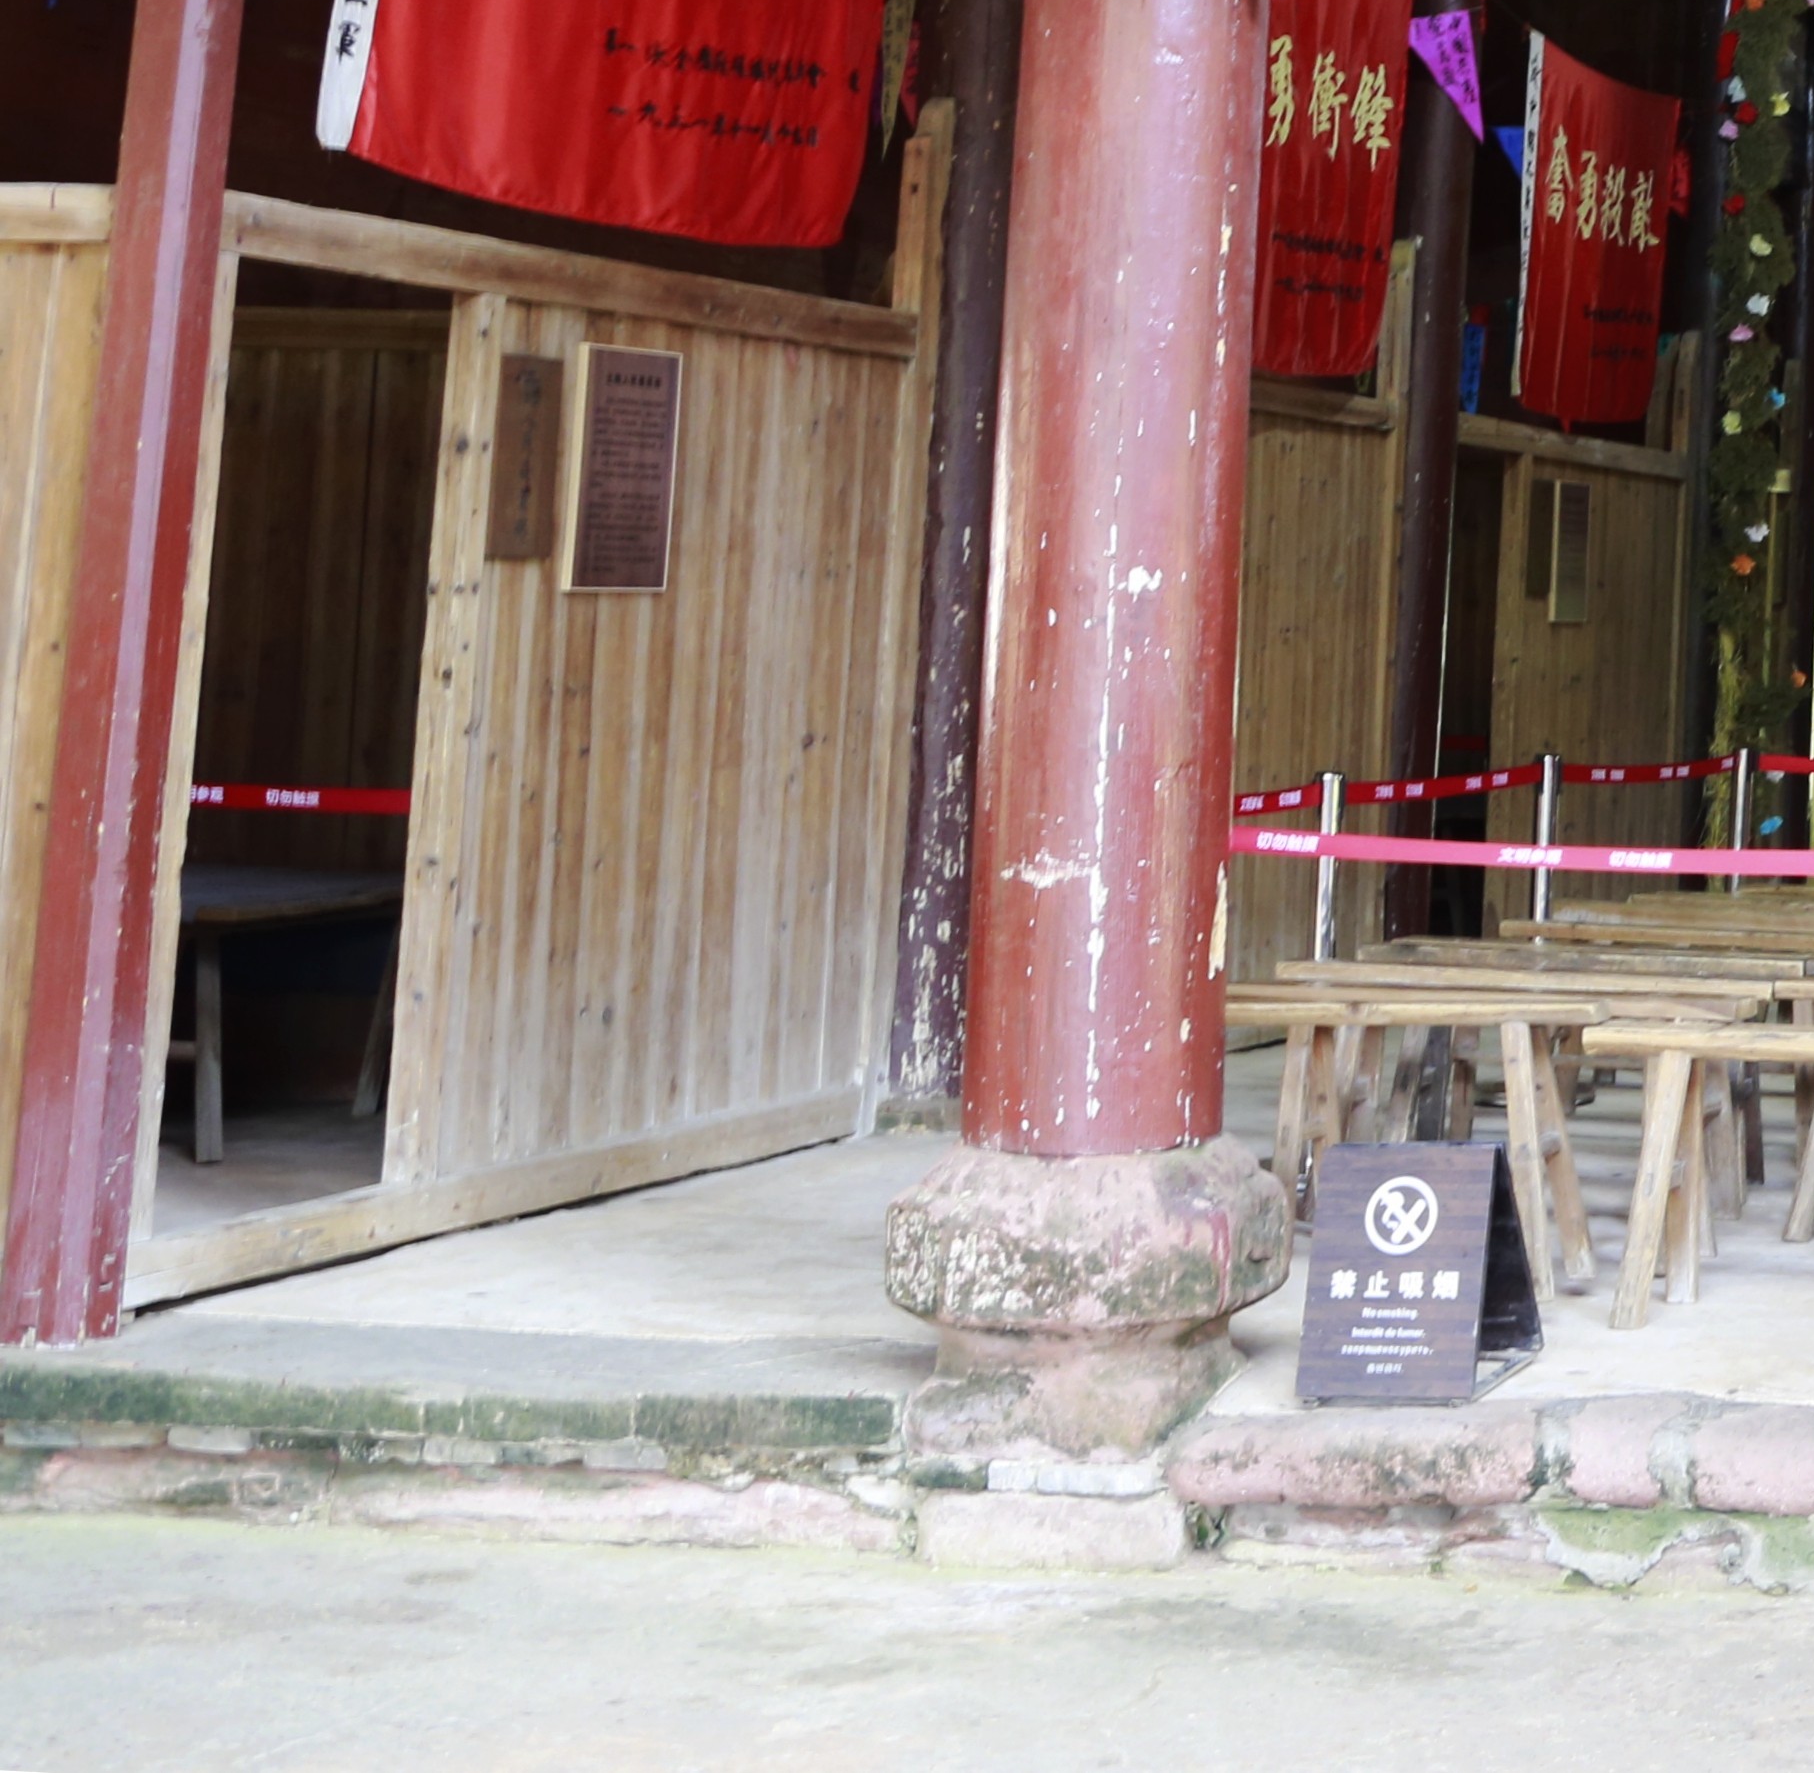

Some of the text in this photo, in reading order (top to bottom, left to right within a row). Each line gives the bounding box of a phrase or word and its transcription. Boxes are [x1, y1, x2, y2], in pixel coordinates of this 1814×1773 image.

[1256, 832, 1320, 854] 切勿触摸
[1498, 847, 1563, 866] 文明参观
[1609, 850, 1672, 869] 切勿触摸
[1330, 1270, 1460, 1300] 禁止吸烟
